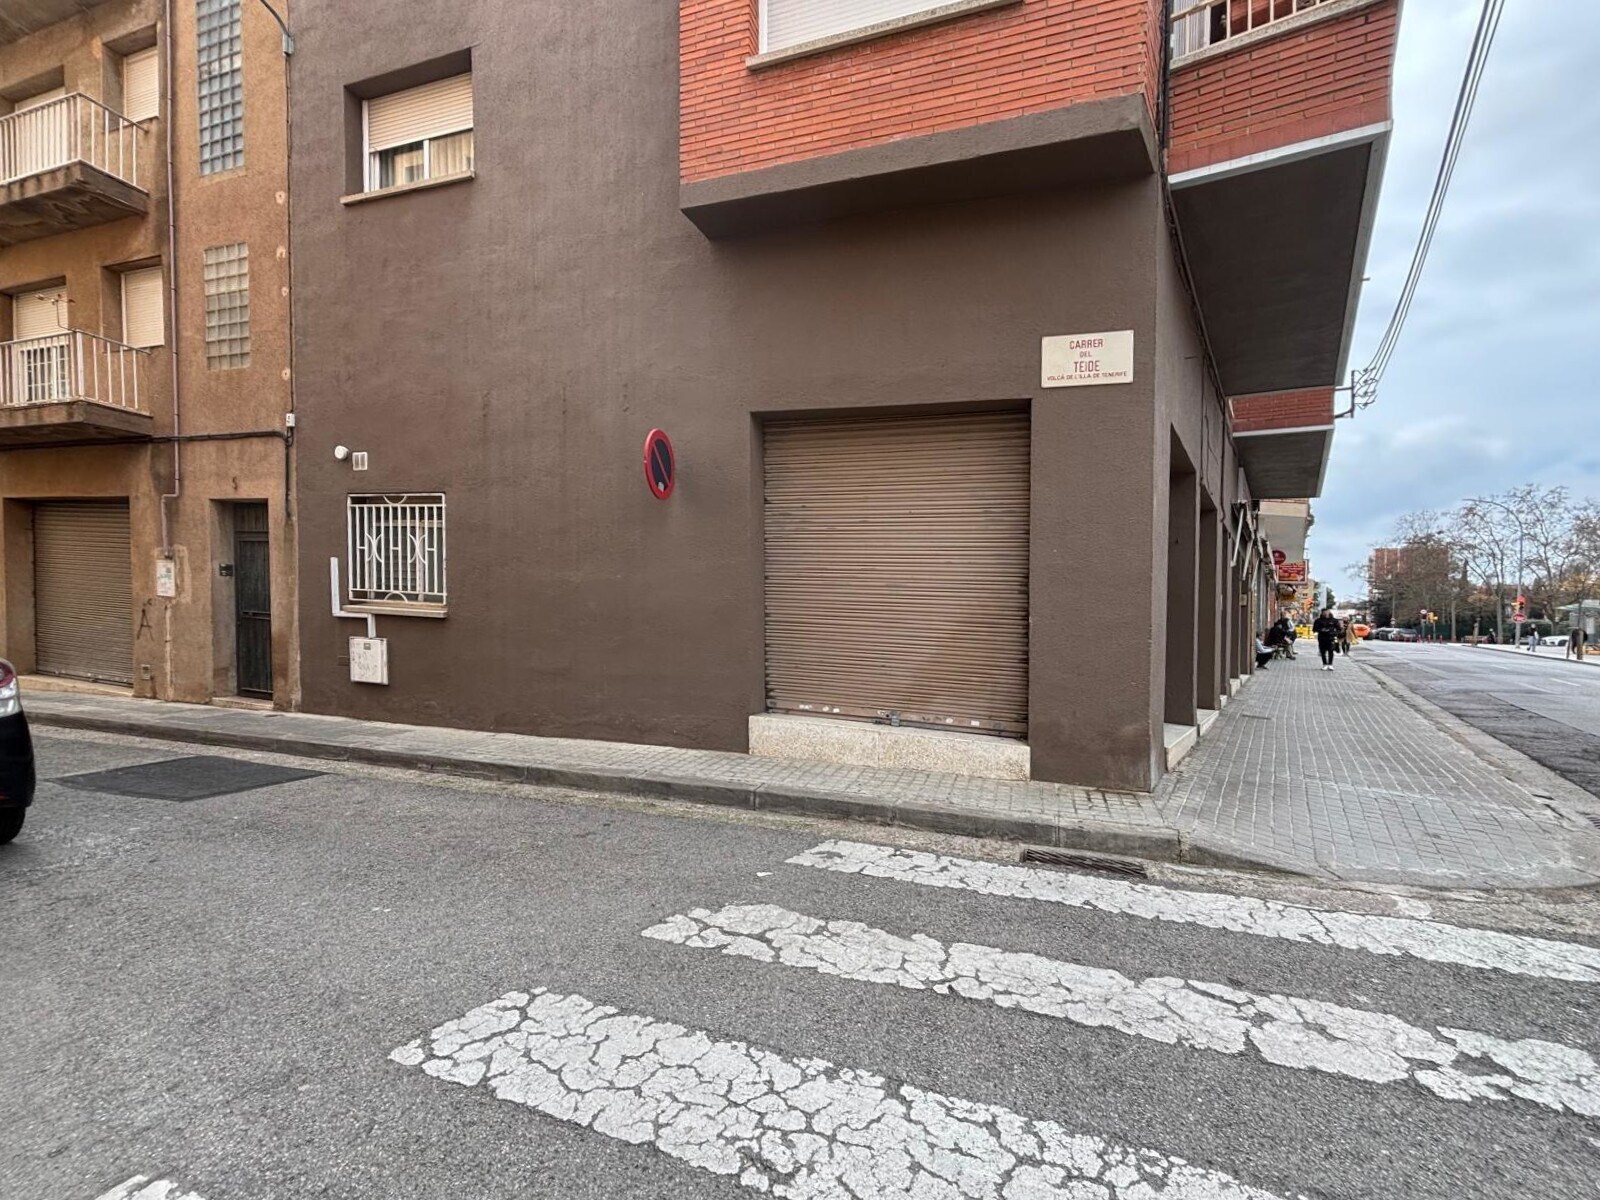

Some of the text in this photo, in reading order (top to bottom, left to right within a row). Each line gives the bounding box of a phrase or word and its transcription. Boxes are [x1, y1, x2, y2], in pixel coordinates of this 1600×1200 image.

[1069, 338, 1103, 349] CARRER
[1079, 350, 1093, 358] DEL
[1073, 360, 1100, 373] TEIDE
